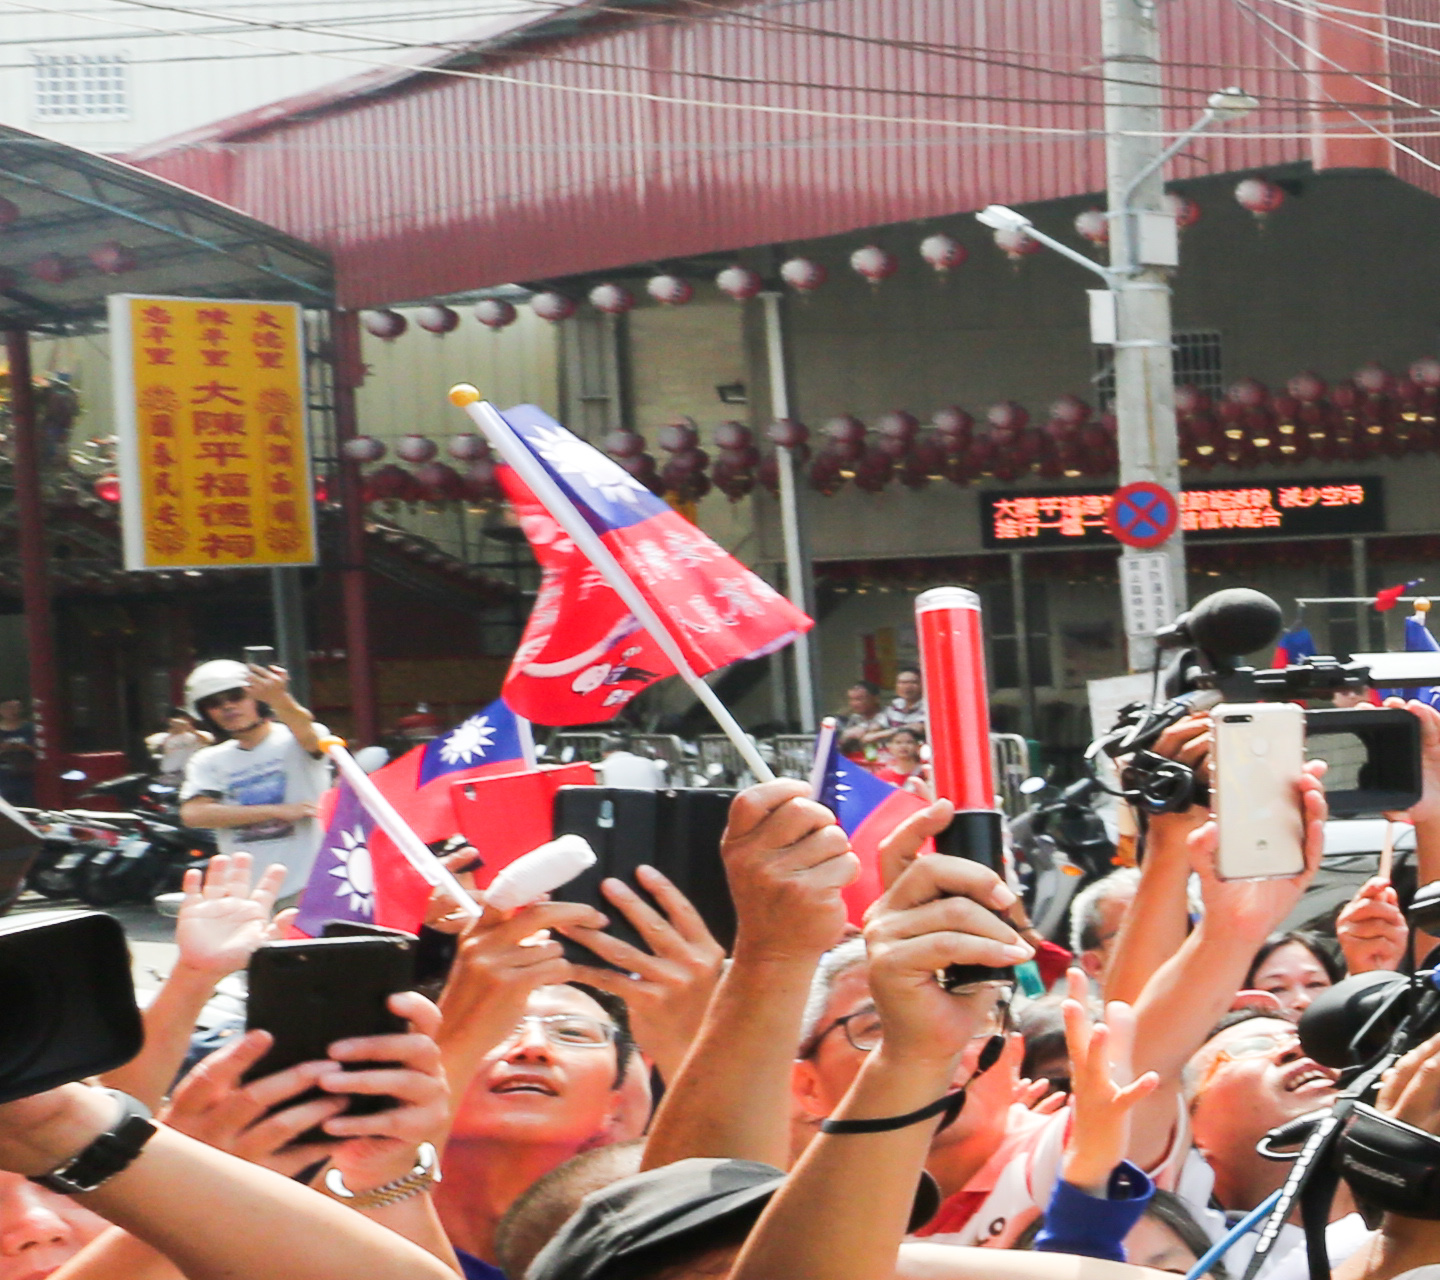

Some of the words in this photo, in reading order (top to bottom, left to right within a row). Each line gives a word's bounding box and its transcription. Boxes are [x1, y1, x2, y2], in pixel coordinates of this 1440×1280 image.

[190, 381, 257, 558] 大陳平福德祠
